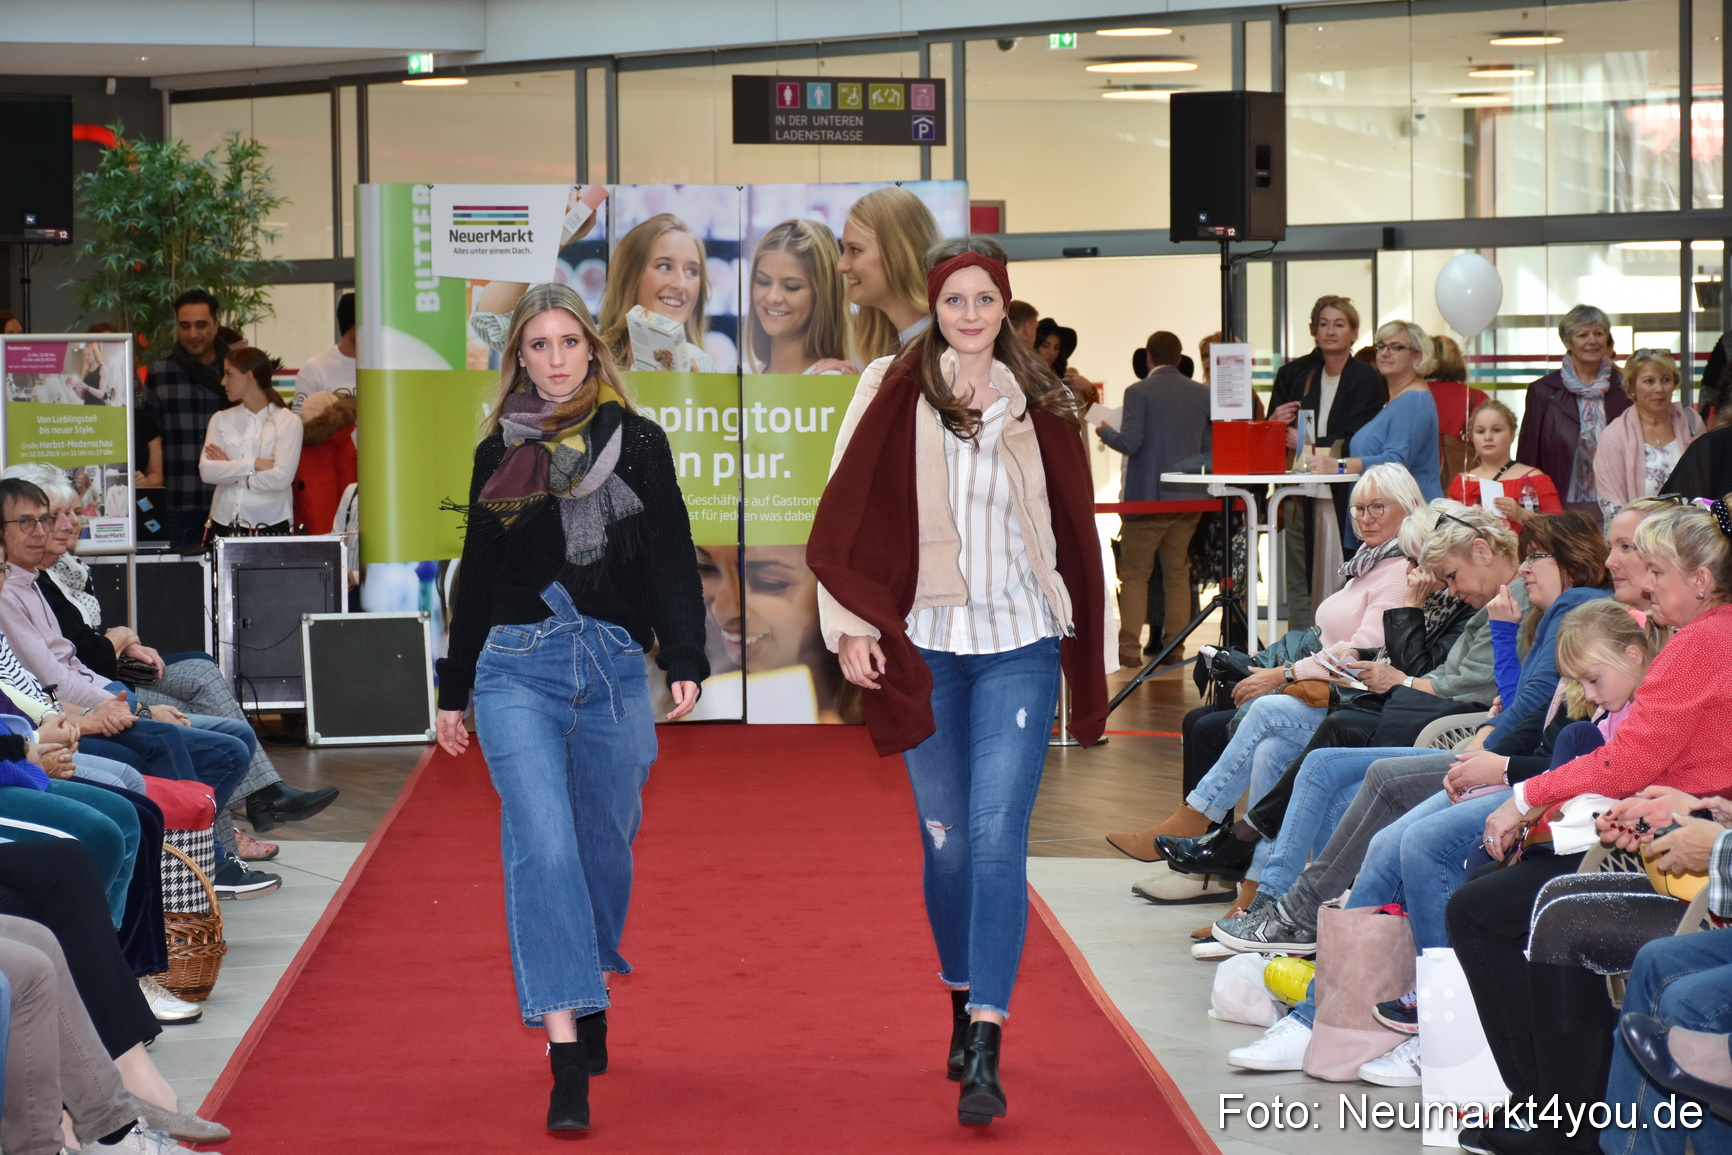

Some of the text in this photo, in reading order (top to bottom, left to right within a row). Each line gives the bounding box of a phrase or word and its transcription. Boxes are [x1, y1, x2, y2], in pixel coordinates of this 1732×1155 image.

[775, 115, 864, 126] IN DER UNTEREN
[775, 130, 864, 141] LADENSTRASSE
[918, 123, 930, 140] P
[59, 230, 68, 239] 12
[449, 228, 534, 243] NeuerMarkt
[1227, 228, 1236, 236] 12
[453, 247, 469, 255] Alles
[489, 247, 511, 255] einem
[512, 247, 532, 255] Dach.
[37, 414, 98, 424] Von Lieblingsteil
[39, 425, 96, 435] bis neuer Style.
[39, 440, 114, 449] Herbst-Modenschau
[713, 452, 791, 487] pur.
[687, 494, 749, 506] Geschäfte
[751, 495, 770, 506] auf
[702, 509, 718, 521] für
[720, 510, 757, 523] jeden
[759, 512, 782, 521] was
[784, 510, 815, 521] dabei
